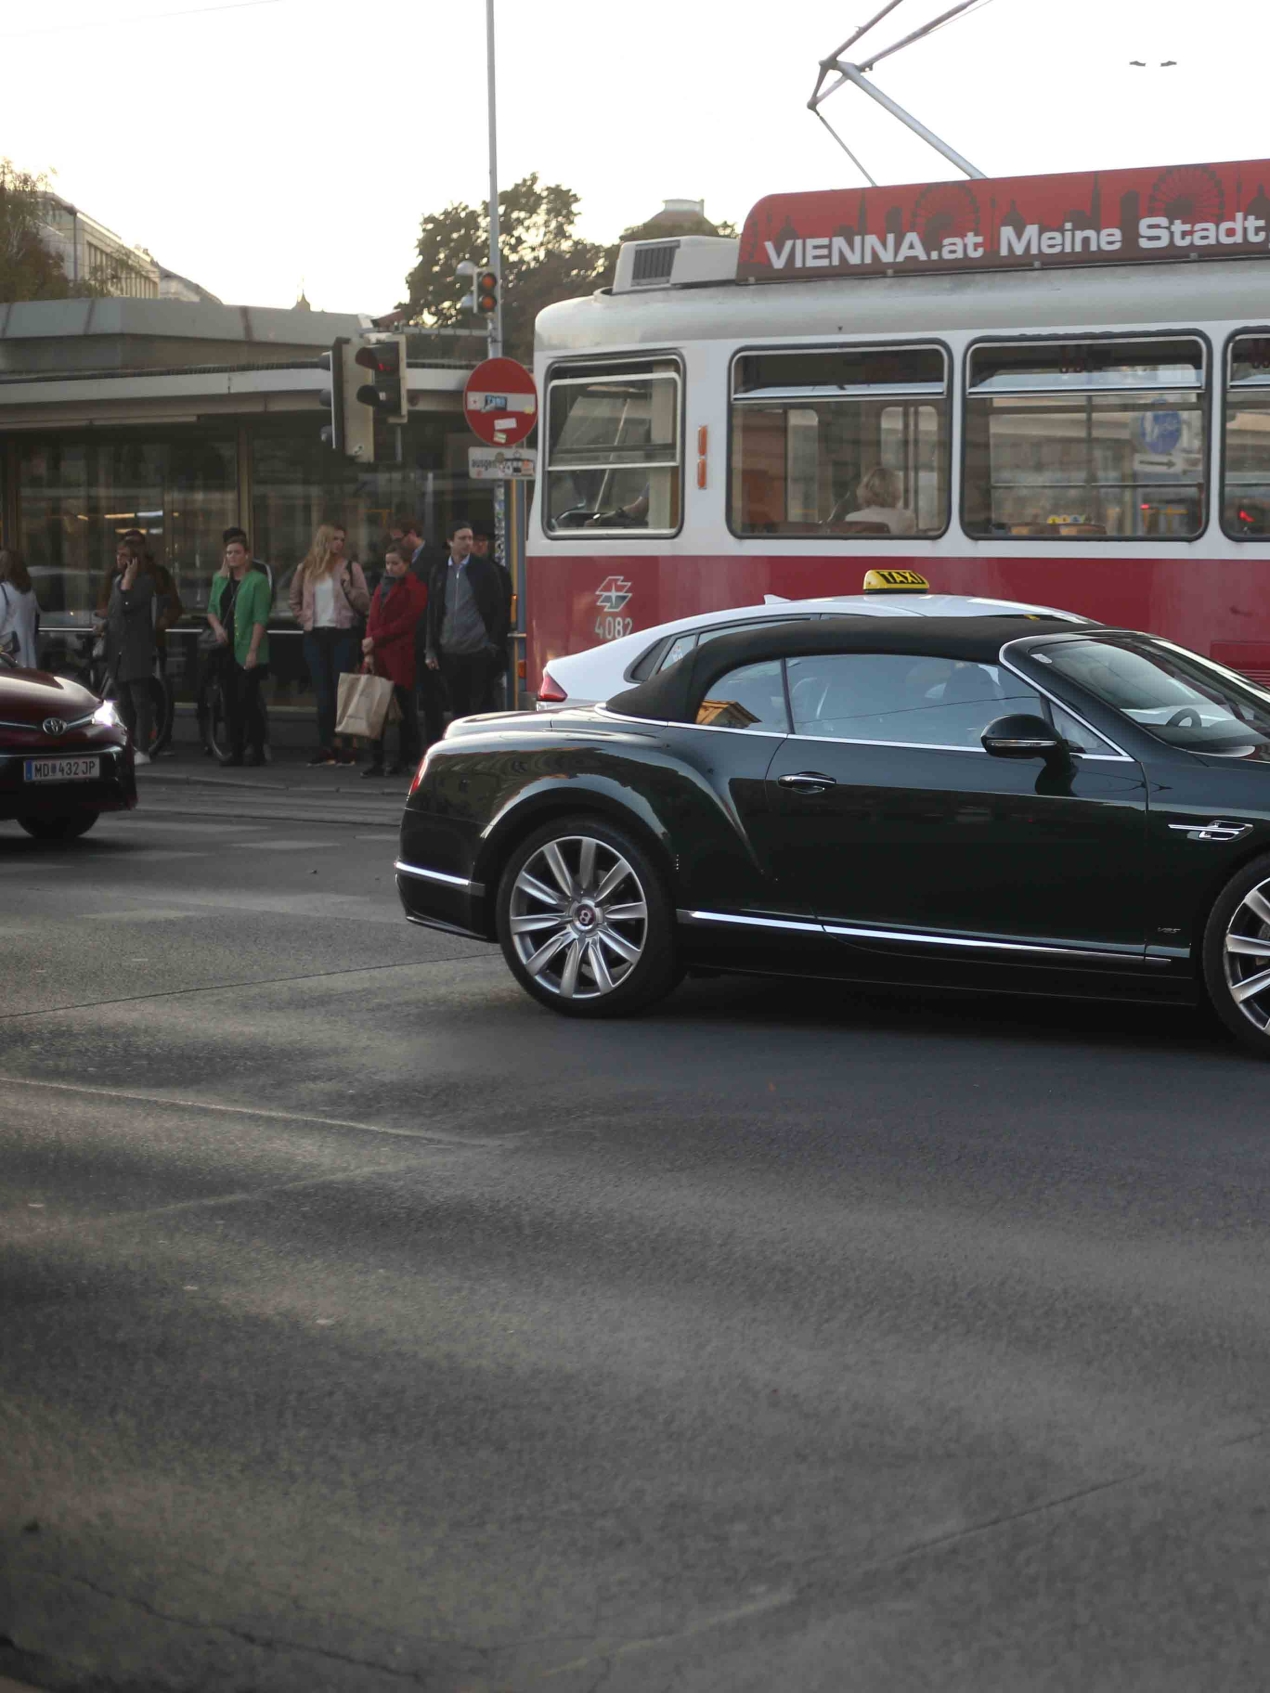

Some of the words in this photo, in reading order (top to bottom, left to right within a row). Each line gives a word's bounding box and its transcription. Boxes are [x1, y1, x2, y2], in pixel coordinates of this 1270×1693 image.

[764, 231, 985, 270] VIENNA.at
[1000, 222, 1122, 256] Meine
[879, 571, 924, 584] TAXI
[594, 615, 633, 640] 4082
[34, 763, 50, 778] MD
[58, 761, 80, 777] 432
[82, 760, 96, 775] JP
